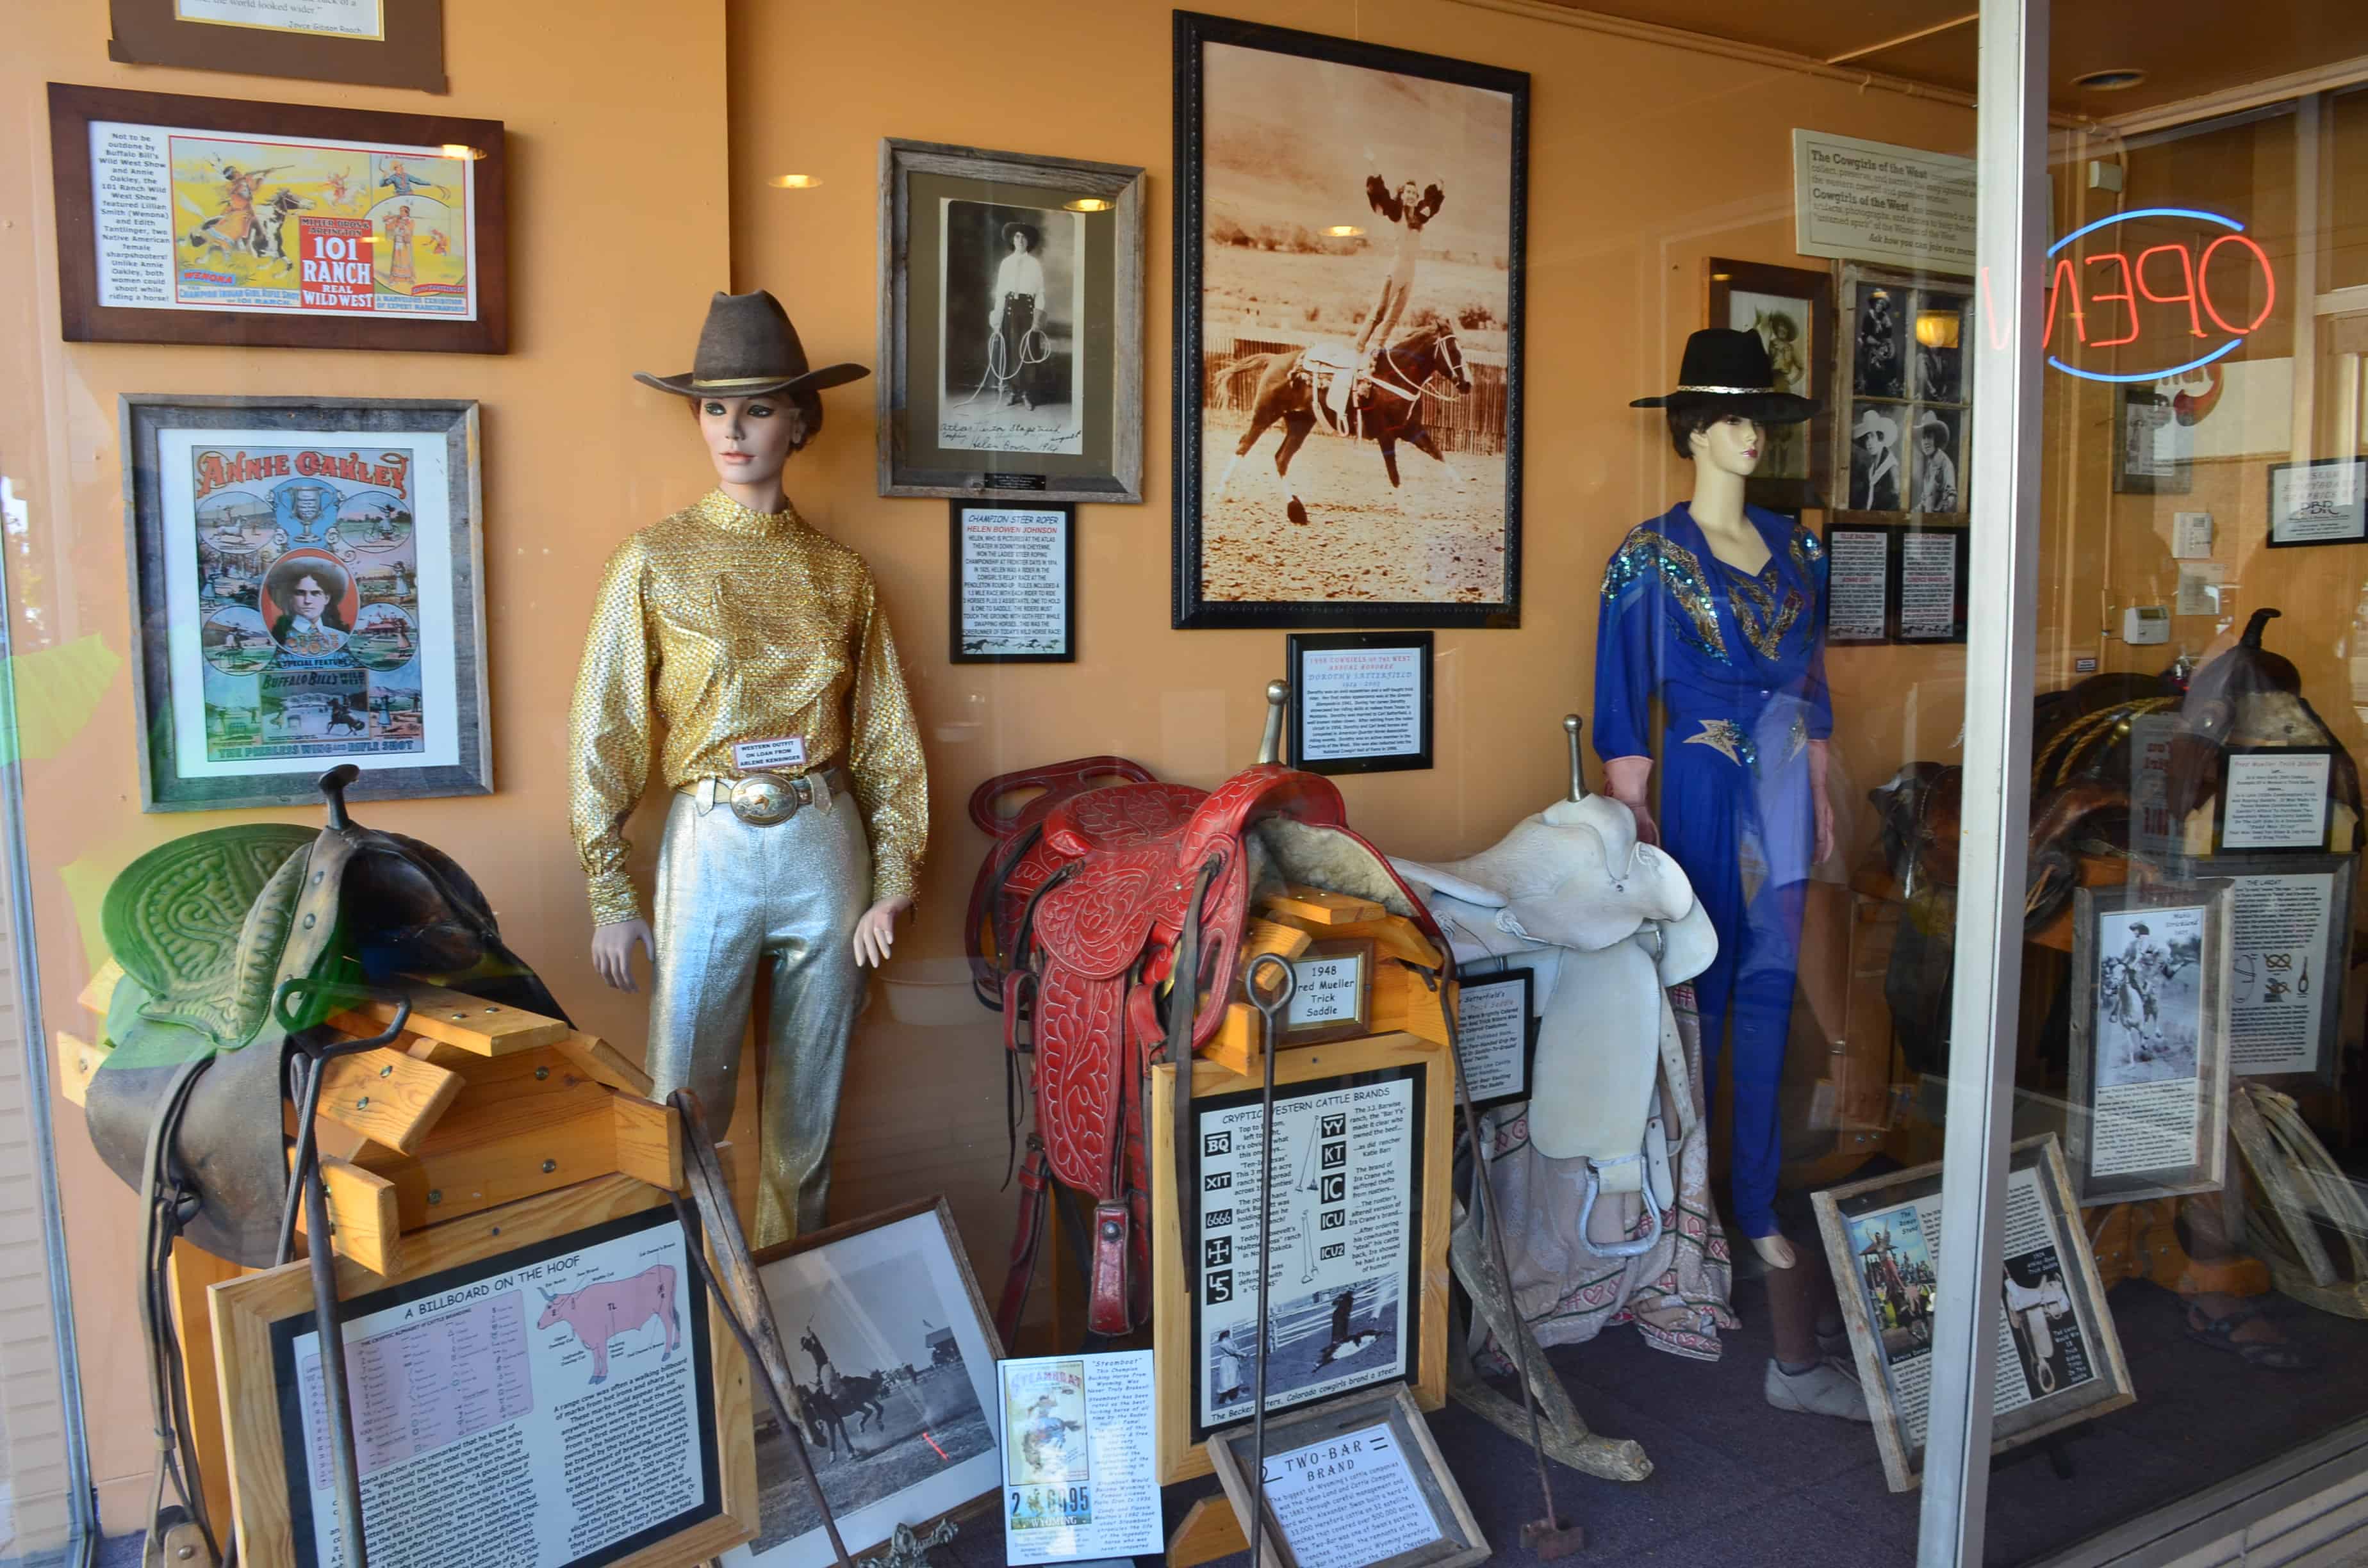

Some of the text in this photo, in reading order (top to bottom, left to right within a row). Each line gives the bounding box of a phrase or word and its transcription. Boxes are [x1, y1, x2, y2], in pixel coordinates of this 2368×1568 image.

[258, 2, 287, 12] looked
[106, 149, 136, 158] Buffalo
[1812, 150, 1927, 179] The Cowgirls of the West
[1813, 188, 1908, 211] Cowgirls of the West
[302, 218, 334, 228] MILLER
[308, 227, 362, 237] ARLINGTON
[314, 236, 359, 261] 101
[184, 272, 233, 284] WENONA
[302, 260, 372, 284] RANCH
[322, 284, 353, 293] REAL
[302, 290, 338, 306] WILD
[338, 293, 374, 308] WEST
[196, 451, 409, 499] ANNIE OAKLEY
[968, 514, 1008, 523] CHAMPION
[1010, 516, 1034, 524] STEER
[281, 659, 313, 667] SPECIAL
[263, 673, 308, 689] BUFFALO
[308, 673, 338, 686] BILL'S
[1312, 965, 1338, 977] 1948
[1297, 979, 1354, 993] red Mueller
[1311, 994, 1336, 1004] Trick
[1306, 1007, 1338, 1017] Saddle
[1222, 1088, 1390, 1124] CRYPTIC ESTERN CATTLE BRANDS
[1324, 1120, 1344, 1136] YY
[1206, 1138, 1229, 1153] BQ
[1325, 1145, 1344, 1163] KT
[1206, 1175, 1231, 1189] XIT
[1324, 1177, 1343, 1201] IC
[1207, 1211, 1231, 1226] 6666
[1322, 1212, 1343, 1229] ICU
[1240, 1234, 1260, 1243] Teddy
[1322, 1245, 1344, 1259] ICU2
[405, 1255, 580, 1319] A BILLBOARD ON THE HOOF
[1092, 1357, 1143, 1367] "Steamboat"
[560, 1400, 580, 1409] range
[581, 1394, 595, 1403] cow
[611, 1381, 628, 1391] often
[634, 1369, 660, 1382] walking
[661, 1357, 687, 1372] billboard
[564, 1405, 585, 1417] marks
[586, 1399, 602, 1409] from
[604, 1394, 615, 1403] hot
[616, 1387, 633, 1397] irons
[634, 1382, 646, 1391] and
[647, 1376, 665, 1386] sharp
[1211, 1411, 1226, 1422] The
[1229, 1405, 1254, 1417] Becker
[1287, 1389, 1317, 1403] Colorado
[1319, 1380, 1347, 1395] cowgirls
[1349, 1375, 1369, 1386] brand
[1378, 1367, 1397, 1378] steer!
[1285, 1440, 1362, 1472] TWO-BAR
[1307, 1459, 1354, 1482] BRAND
[1283, 1490, 1306, 1501] biggest
[1317, 1477, 1348, 1491] Wyoming's
[1349, 1471, 1367, 1481] cattle
[1369, 1462, 1399, 1474] companies
[1012, 1492, 1020, 1516] 2
[1032, 1515, 1077, 1528] WYOMING
